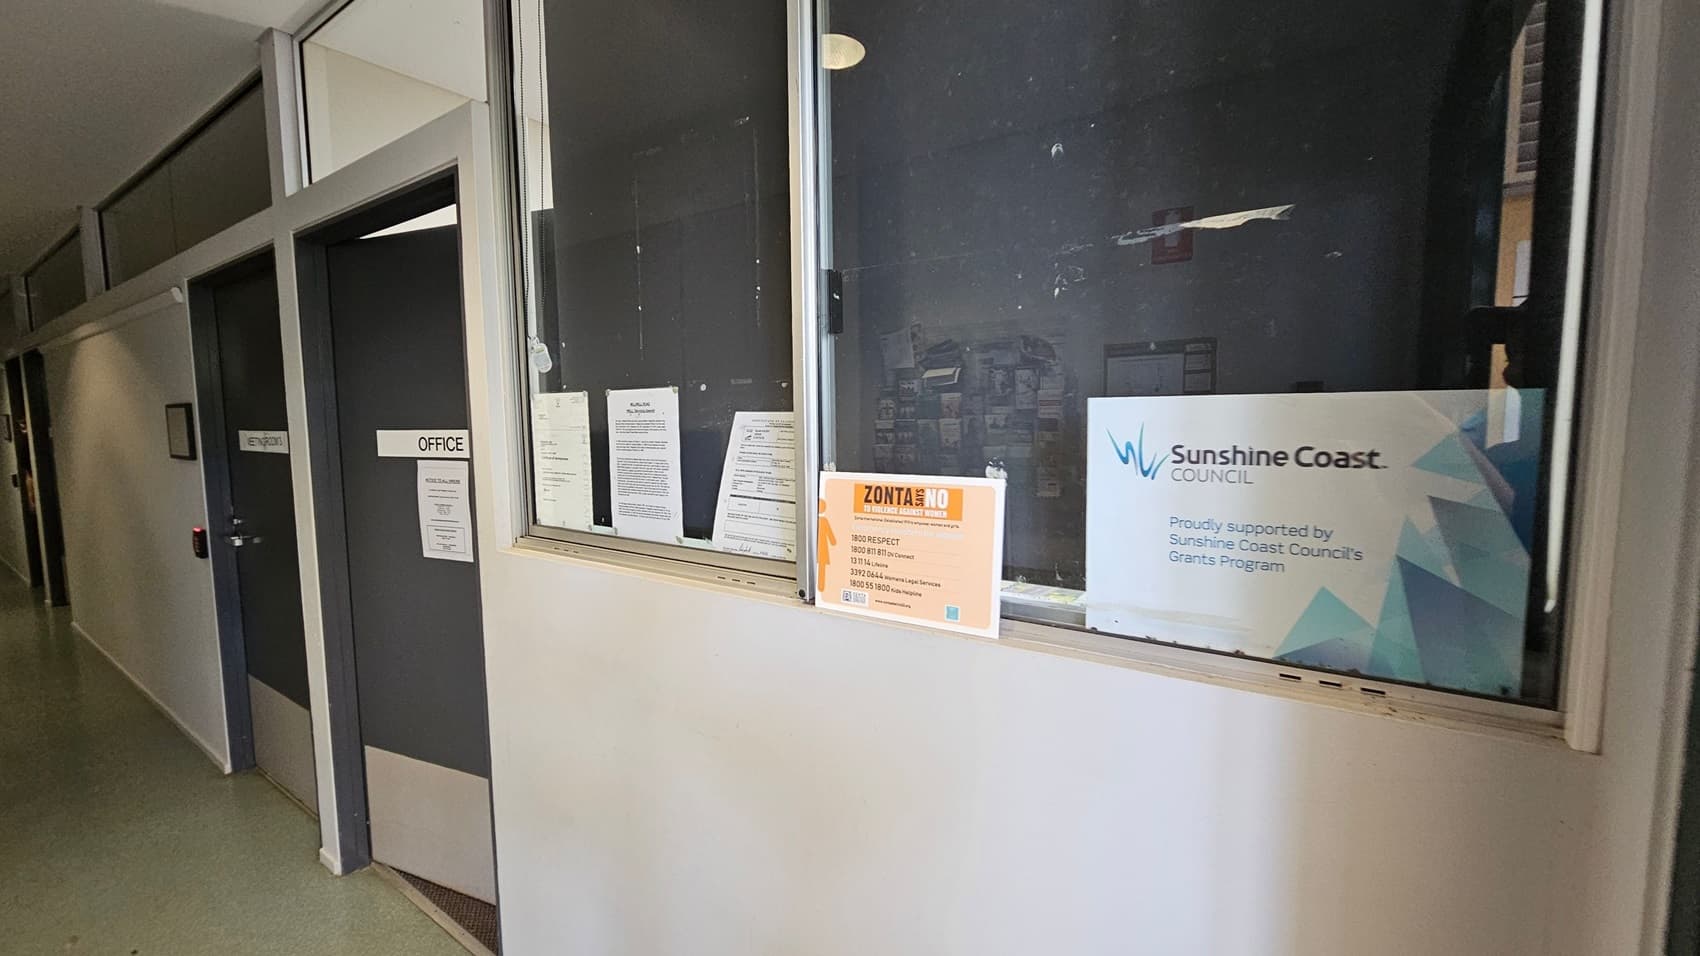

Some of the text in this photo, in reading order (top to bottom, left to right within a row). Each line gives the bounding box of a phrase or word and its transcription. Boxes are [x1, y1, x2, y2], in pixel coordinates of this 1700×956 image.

[418, 436, 464, 452] OFFICE
[1171, 444, 1381, 470] Sunshine Coast
[1171, 468, 1254, 485] COUNCIL
[864, 485, 949, 509] ZONTA SAYS NO
[1169, 516, 1334, 541] Proudly supported by
[851, 534, 900, 546] 1800 RESPECT
[1169, 533, 1363, 562] Sunshine Coast Council's
[850, 557, 857, 565] 13
[864, 558, 871, 566] 14
[851, 545, 866, 554] 1800
[867, 548, 876, 556] 811
[877, 549, 887, 557] 811
[895, 552, 915, 560] Connect
[1169, 551, 1285, 573] Grants Program
[850, 568, 866, 577] 3392
[867, 570, 884, 580] 0644
[905, 577, 919, 586] Legal
[919, 579, 941, 588] Services
[850, 579, 865, 588] 1800
[865, 581, 874, 590] 55
[875, 583, 891, 592] 1800
